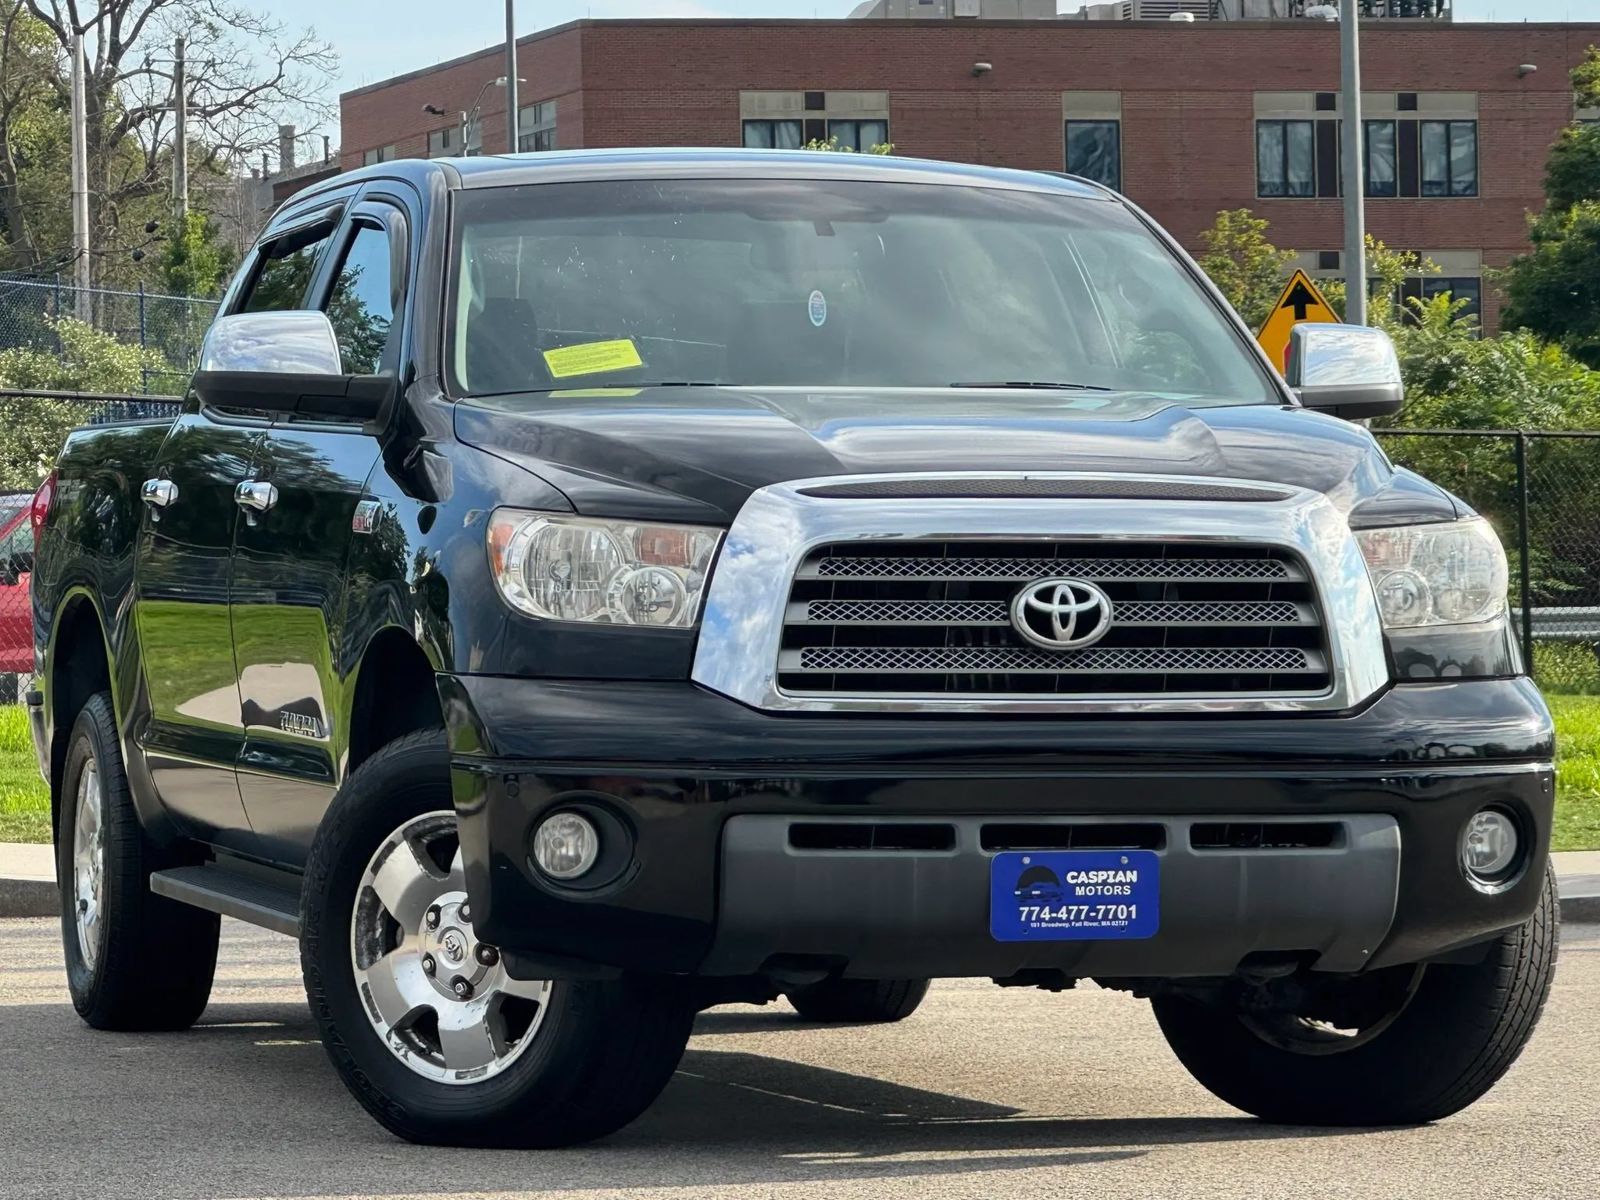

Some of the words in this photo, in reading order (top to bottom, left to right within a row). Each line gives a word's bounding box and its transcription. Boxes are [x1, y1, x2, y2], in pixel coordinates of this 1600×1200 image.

[1066, 870, 1138, 884] CASPIAN
[1075, 885, 1131, 896] MOTORS
[1019, 904, 1137, 921] 774-477-7701
